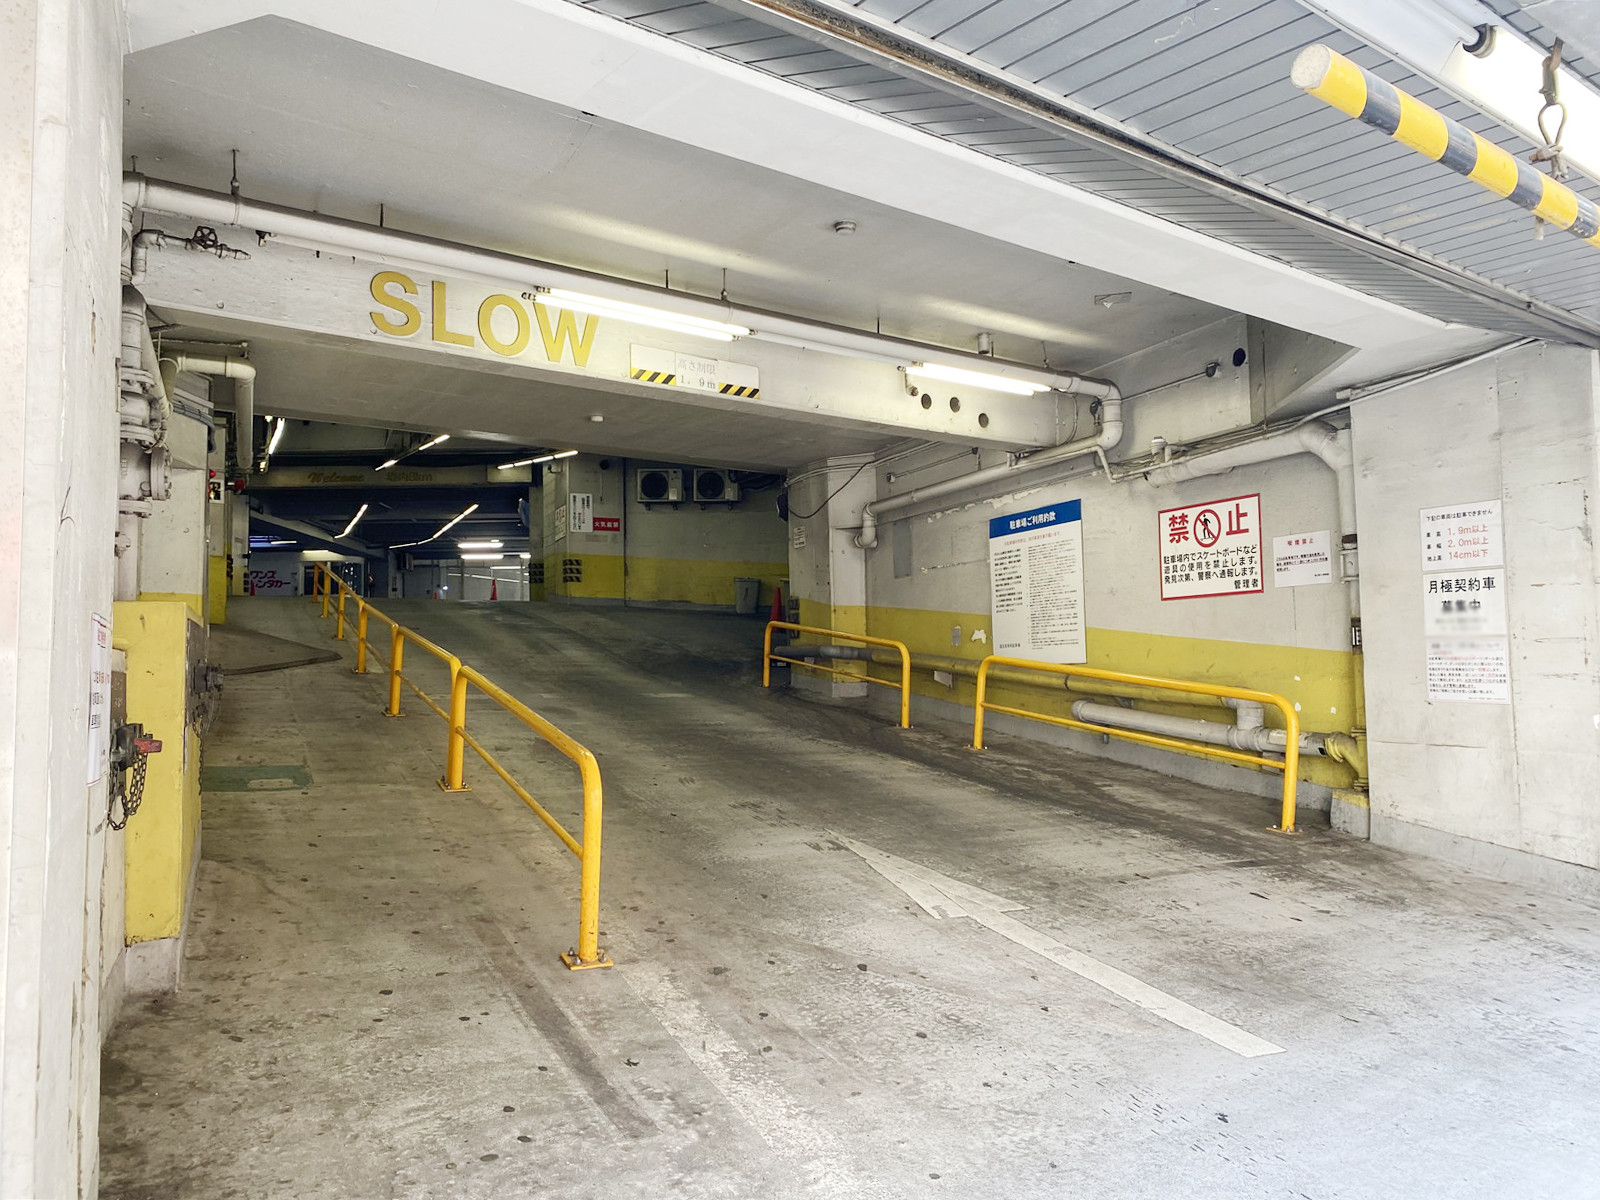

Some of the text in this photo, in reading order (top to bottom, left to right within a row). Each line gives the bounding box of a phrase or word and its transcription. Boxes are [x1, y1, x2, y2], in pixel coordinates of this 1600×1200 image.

[370, 271, 600, 367] SLOW
[677, 358, 717, 375] 高さ制限
[1009, 511, 1057, 530] 駐車場ご利用約款
[1163, 543, 1258, 565] 駐車場内でスケートボードなど
[1448, 548, 1490, 560] 14cm以下
[1164, 555, 1258, 575] 遊具の使用を禁止します。
[250, 570, 277, 580] ワンズ
[1164, 566, 1258, 585] 発見次第、警察へ通報します。
[1234, 578, 1259, 589] 管理者
[1428, 576, 1496, 594] 月極契約車
